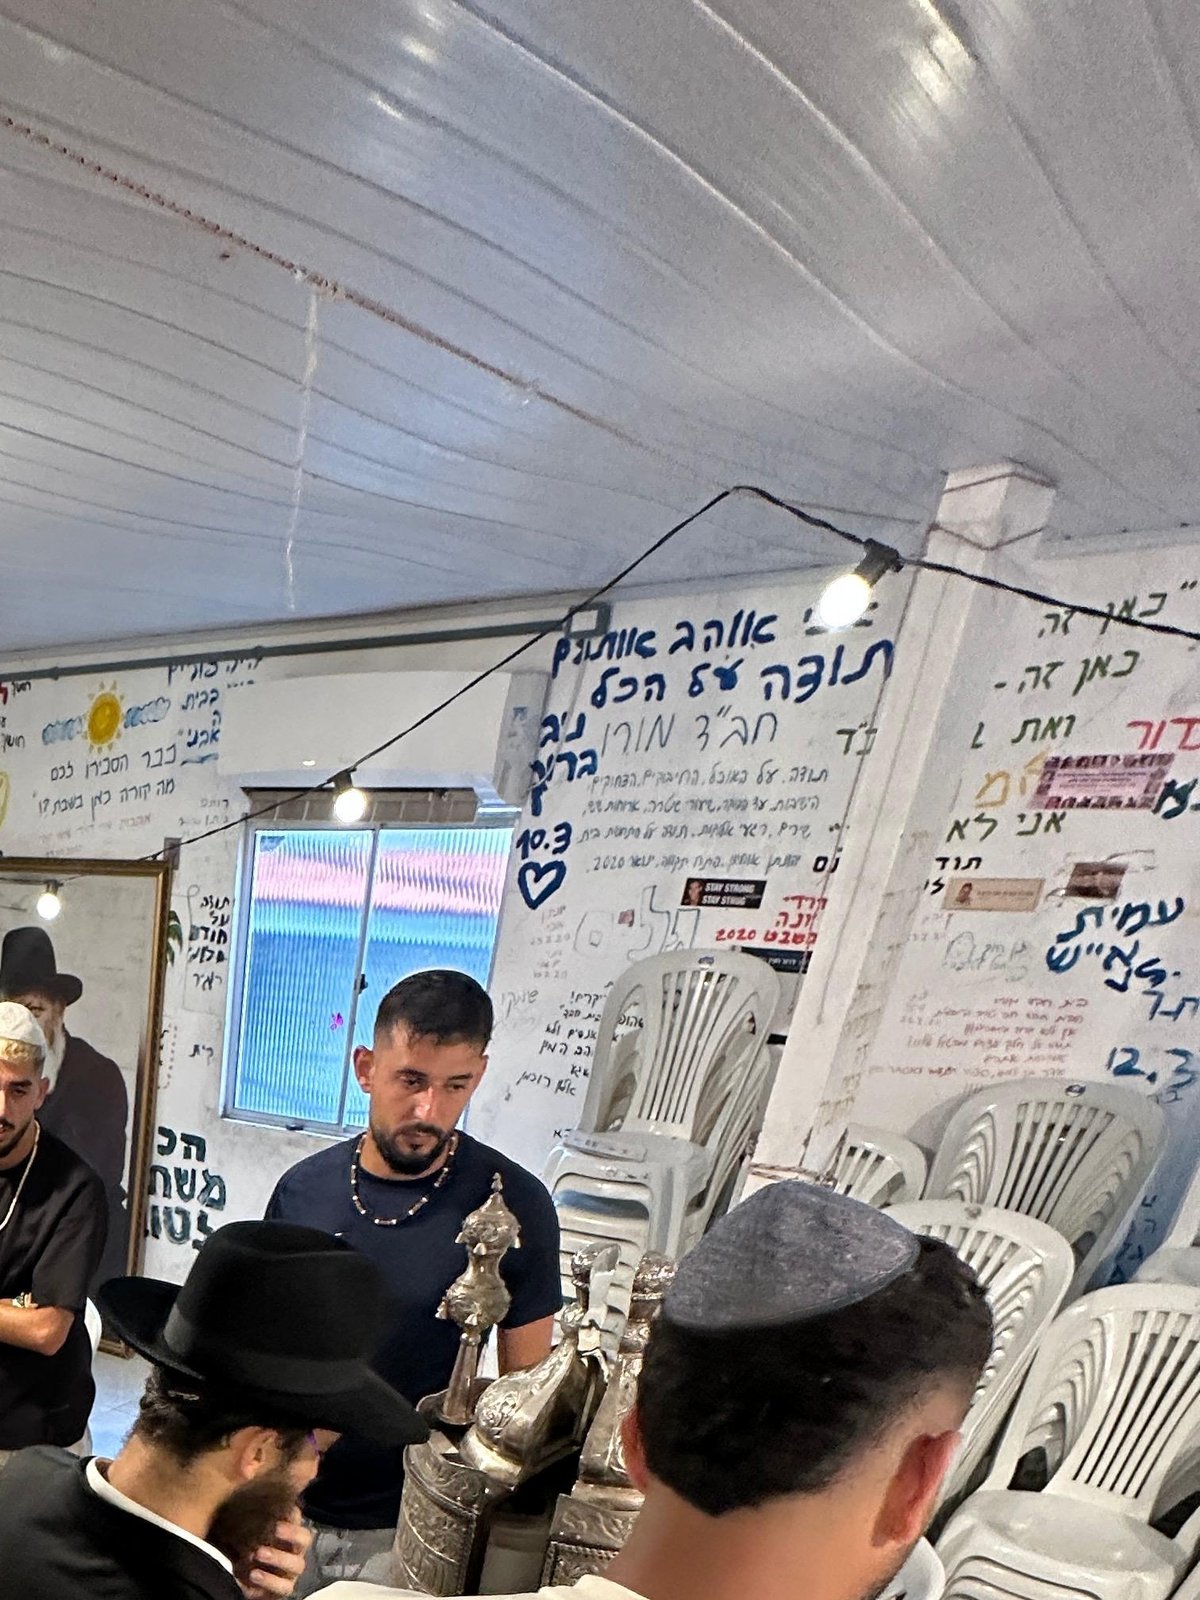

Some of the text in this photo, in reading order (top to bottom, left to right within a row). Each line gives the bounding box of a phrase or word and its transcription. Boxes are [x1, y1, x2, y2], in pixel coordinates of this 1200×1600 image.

[591, 667, 666, 709] הכל
[688, 658, 745, 698] על
[1072, 649, 1140, 697] כאן
[141, 744, 177, 769] כבר
[156, 777, 176, 796] מה
[516, 821, 573, 859] 10.3
[946, 811, 999, 843] לא
[704, 882, 756, 894] STAY STRONG
[715, 928, 757, 941] 2020
[1056, 896, 1185, 944] עמית
